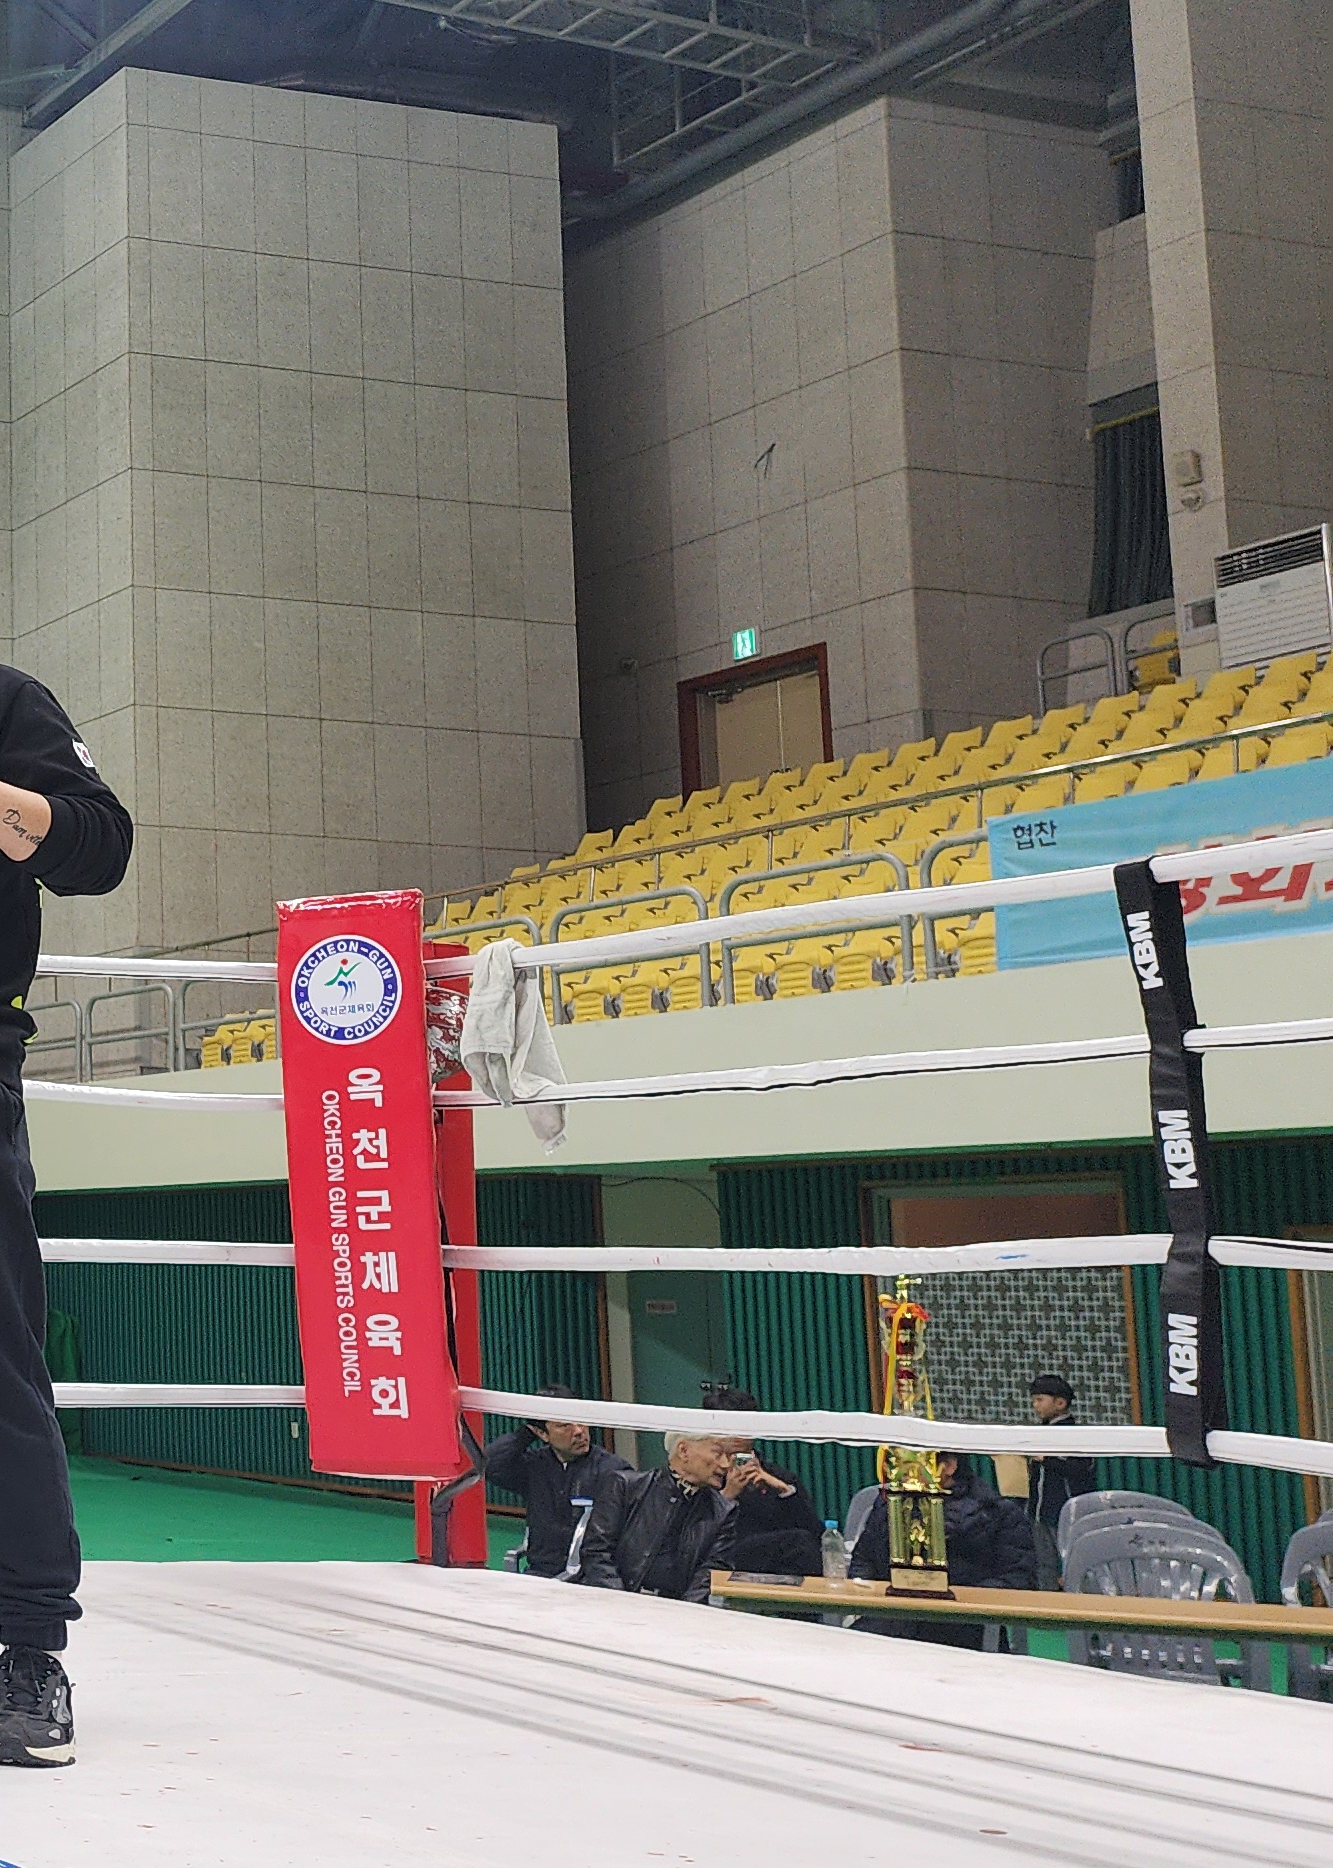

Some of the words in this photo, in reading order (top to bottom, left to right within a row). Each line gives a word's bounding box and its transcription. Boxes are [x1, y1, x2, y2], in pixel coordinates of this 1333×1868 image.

[1012, 819, 1058, 850] 협찬
[297, 941, 394, 988] OKCHEON-GUN
[1126, 910, 1164, 990] KBM
[299, 1001, 339, 1038] SPORT
[344, 992, 396, 1039] COUNCIL
[321, 1089, 345, 1182] OKCHEON
[1158, 1108, 1199, 1190] KBM
[328, 1185, 348, 1228] GUN
[347, 1067, 410, 1419] 옥천군체육회
[331, 1232, 355, 1309] SPORTS
[337, 1312, 362, 1398] COUNCIL
[1169, 1313, 1199, 1396] KBM
